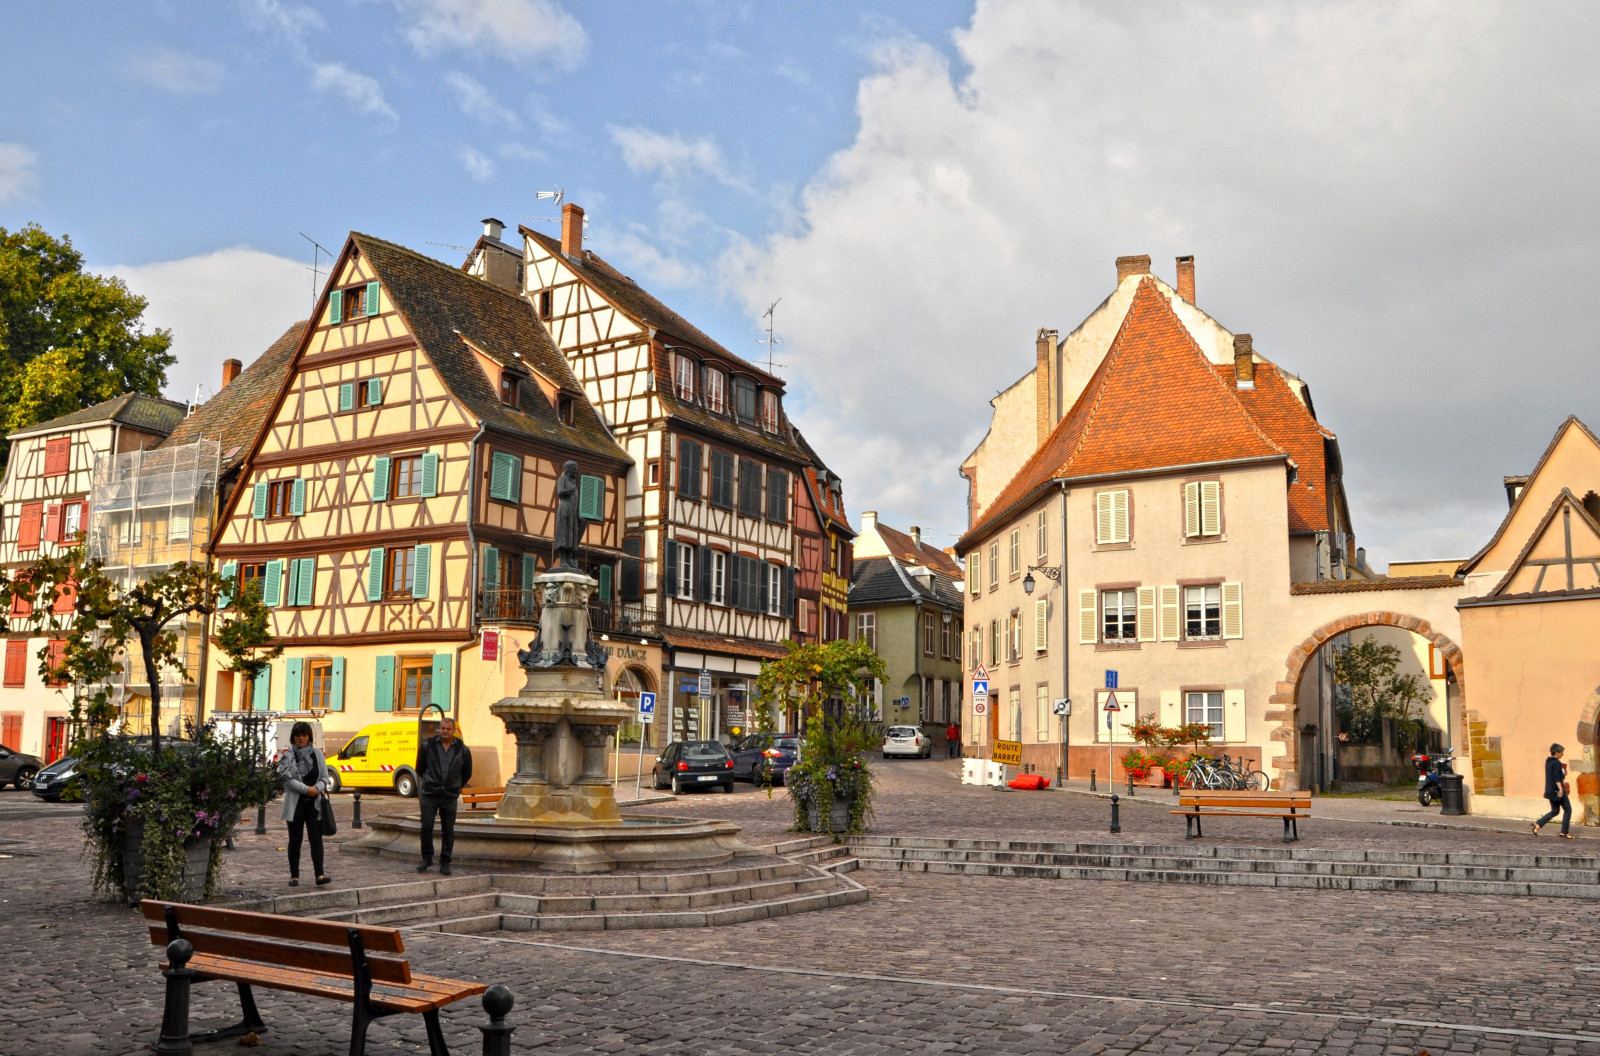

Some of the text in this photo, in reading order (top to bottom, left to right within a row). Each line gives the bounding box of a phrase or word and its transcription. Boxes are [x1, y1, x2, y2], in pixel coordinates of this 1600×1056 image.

[617, 645, 647, 660] D'ANGE
[644, 696, 651, 709] P
[997, 742, 1018, 752] ROUTE
